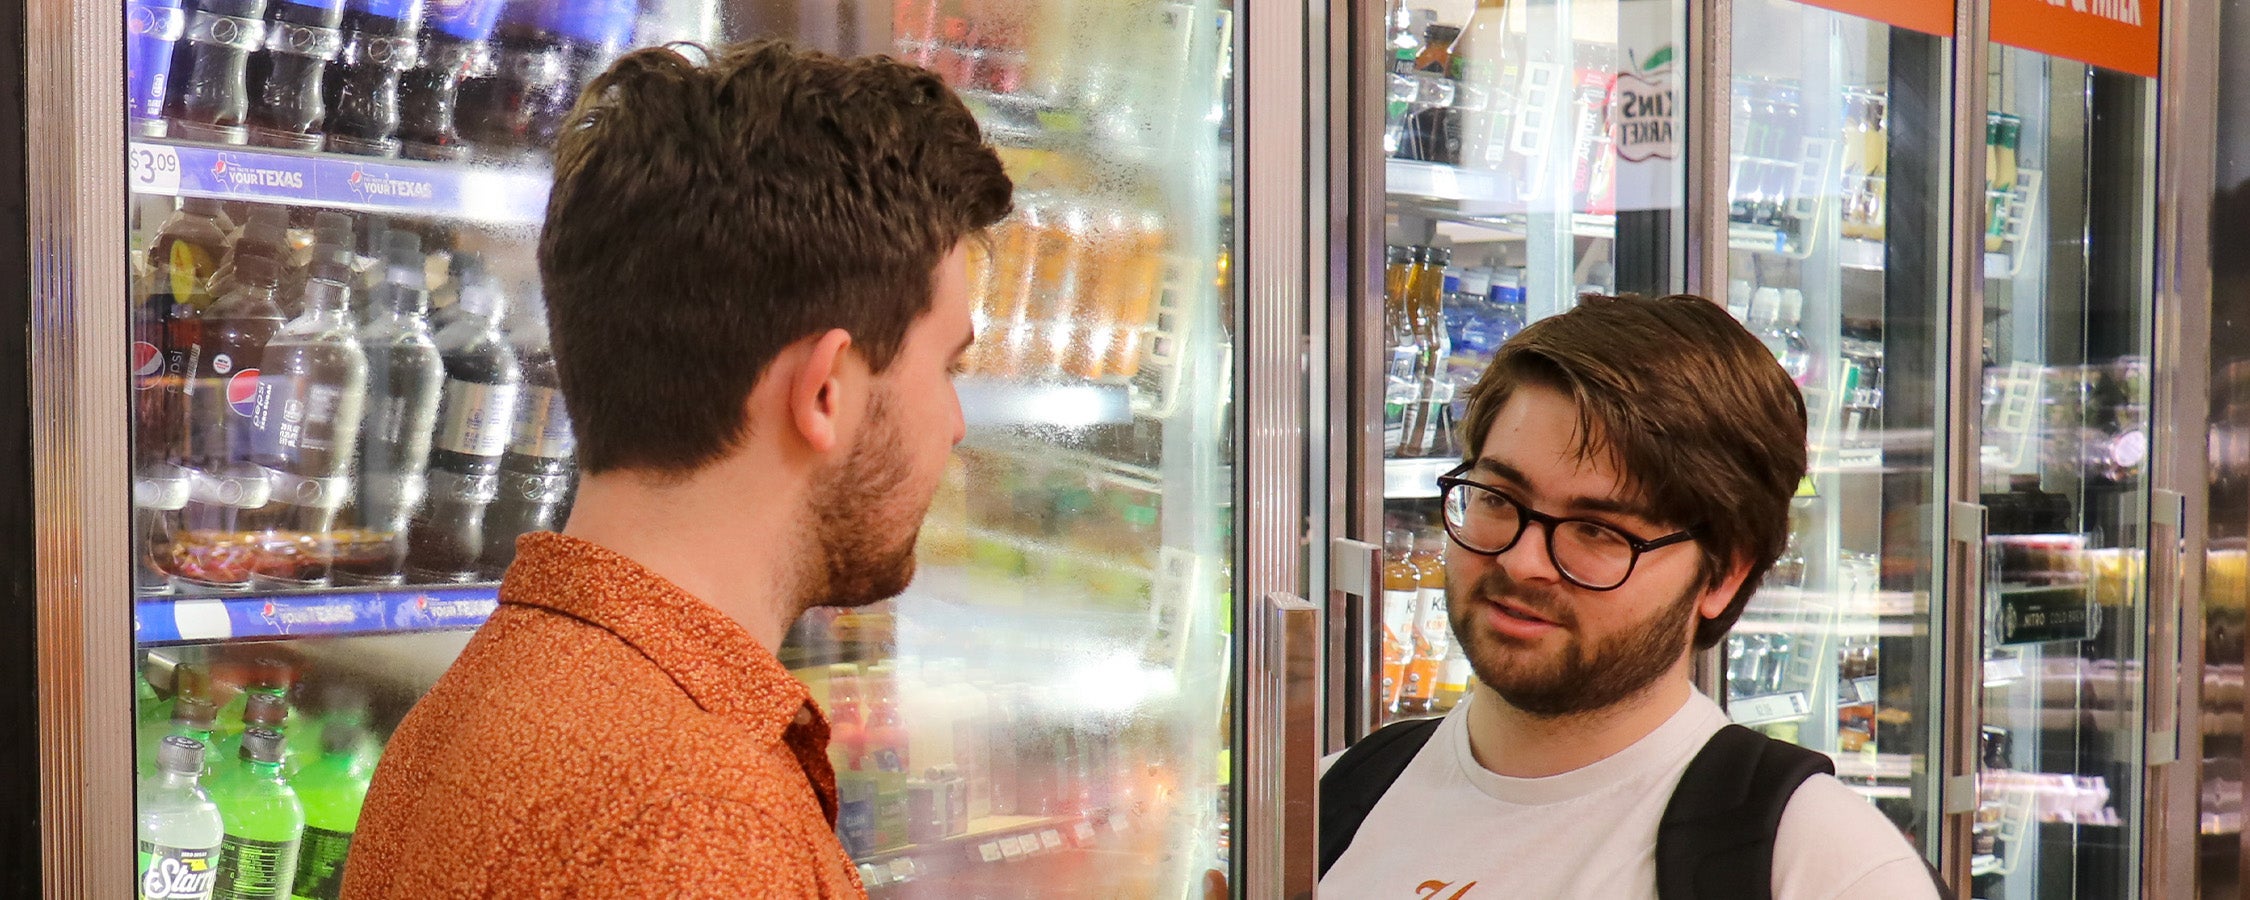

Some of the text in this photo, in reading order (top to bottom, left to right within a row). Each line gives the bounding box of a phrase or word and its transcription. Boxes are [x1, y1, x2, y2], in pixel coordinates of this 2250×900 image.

[130, 148, 176, 183] $3.09
[229, 169, 303, 188] YOUR TEXAS
[166, 350, 182, 394] pepsi
